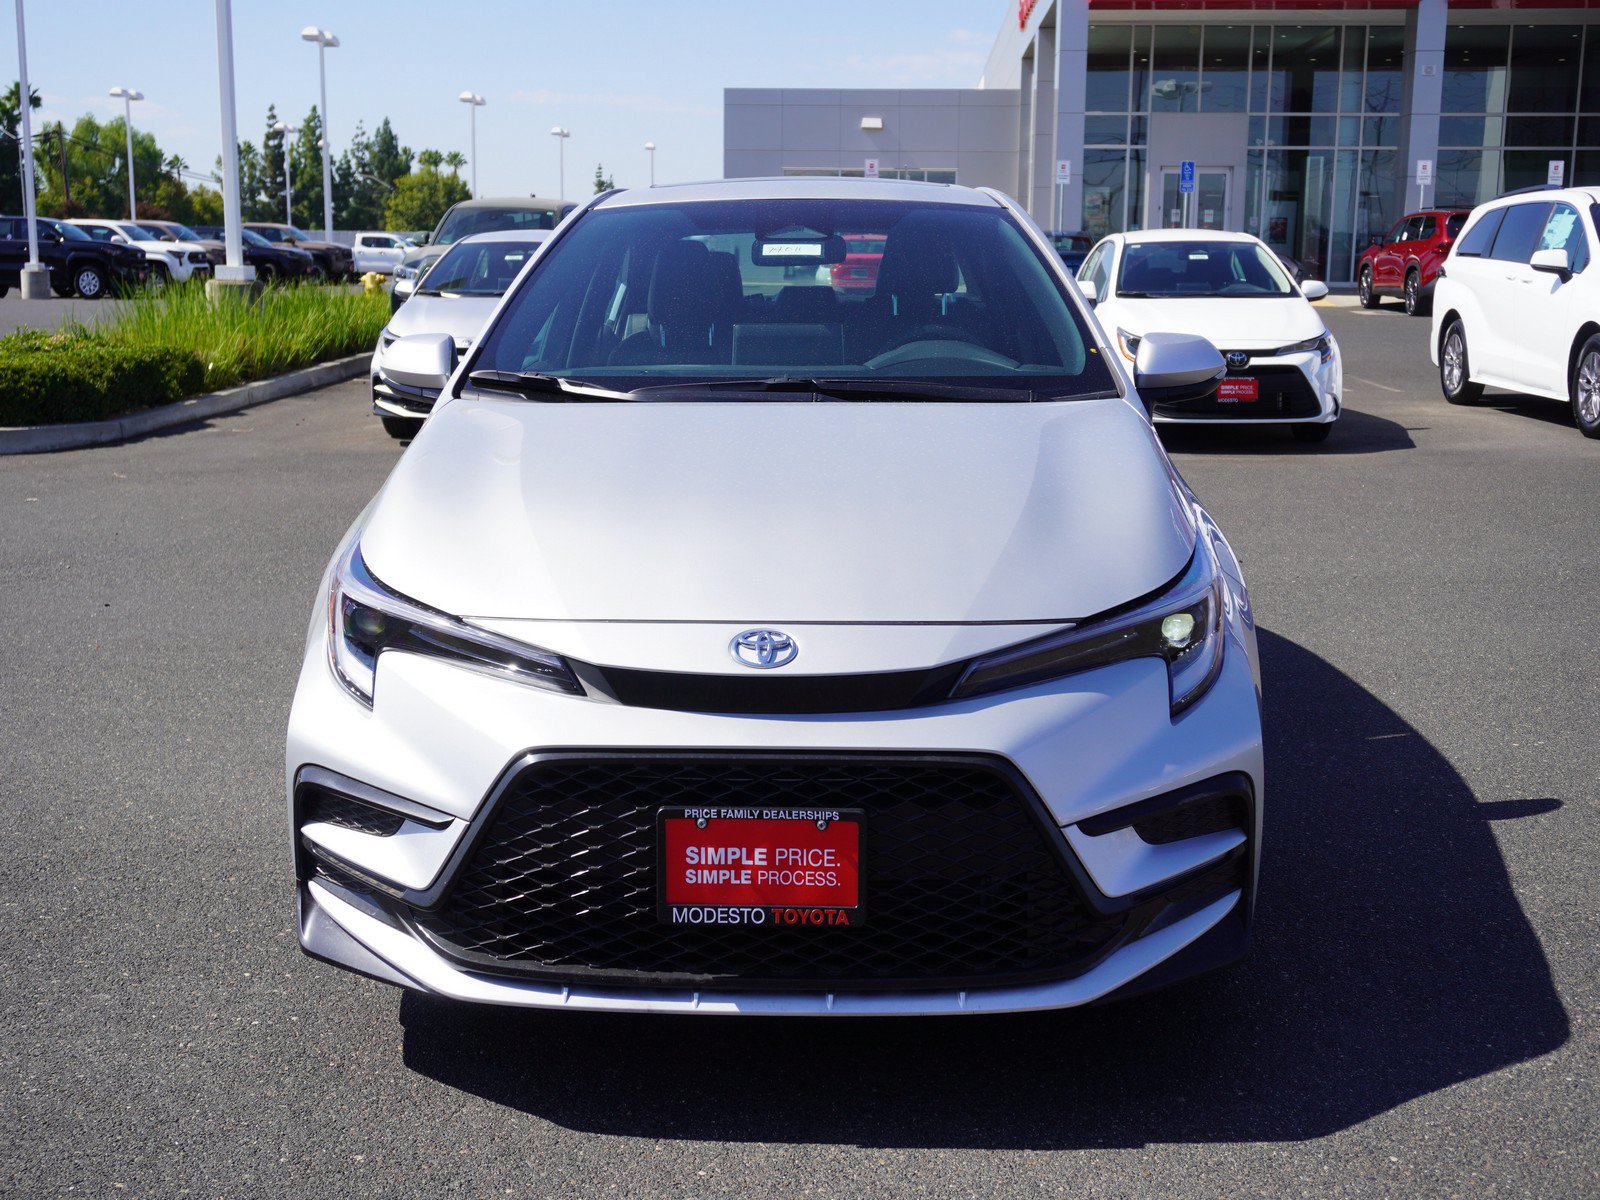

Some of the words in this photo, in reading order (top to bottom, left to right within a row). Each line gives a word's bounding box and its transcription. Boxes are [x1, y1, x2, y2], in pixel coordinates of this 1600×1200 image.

[684, 808, 718, 820] PRICE
[720, 809, 760, 820] FAMILY
[762, 809, 840, 821] DEALERSHIPS
[685, 846, 768, 866] SIMPLE
[775, 847, 841, 867] PRICE.
[685, 868, 752, 885] SIMPLE
[757, 870, 841, 887] PROCESS.
[672, 907, 765, 925] MODESTO
[771, 908, 850, 926] TOYOTA
